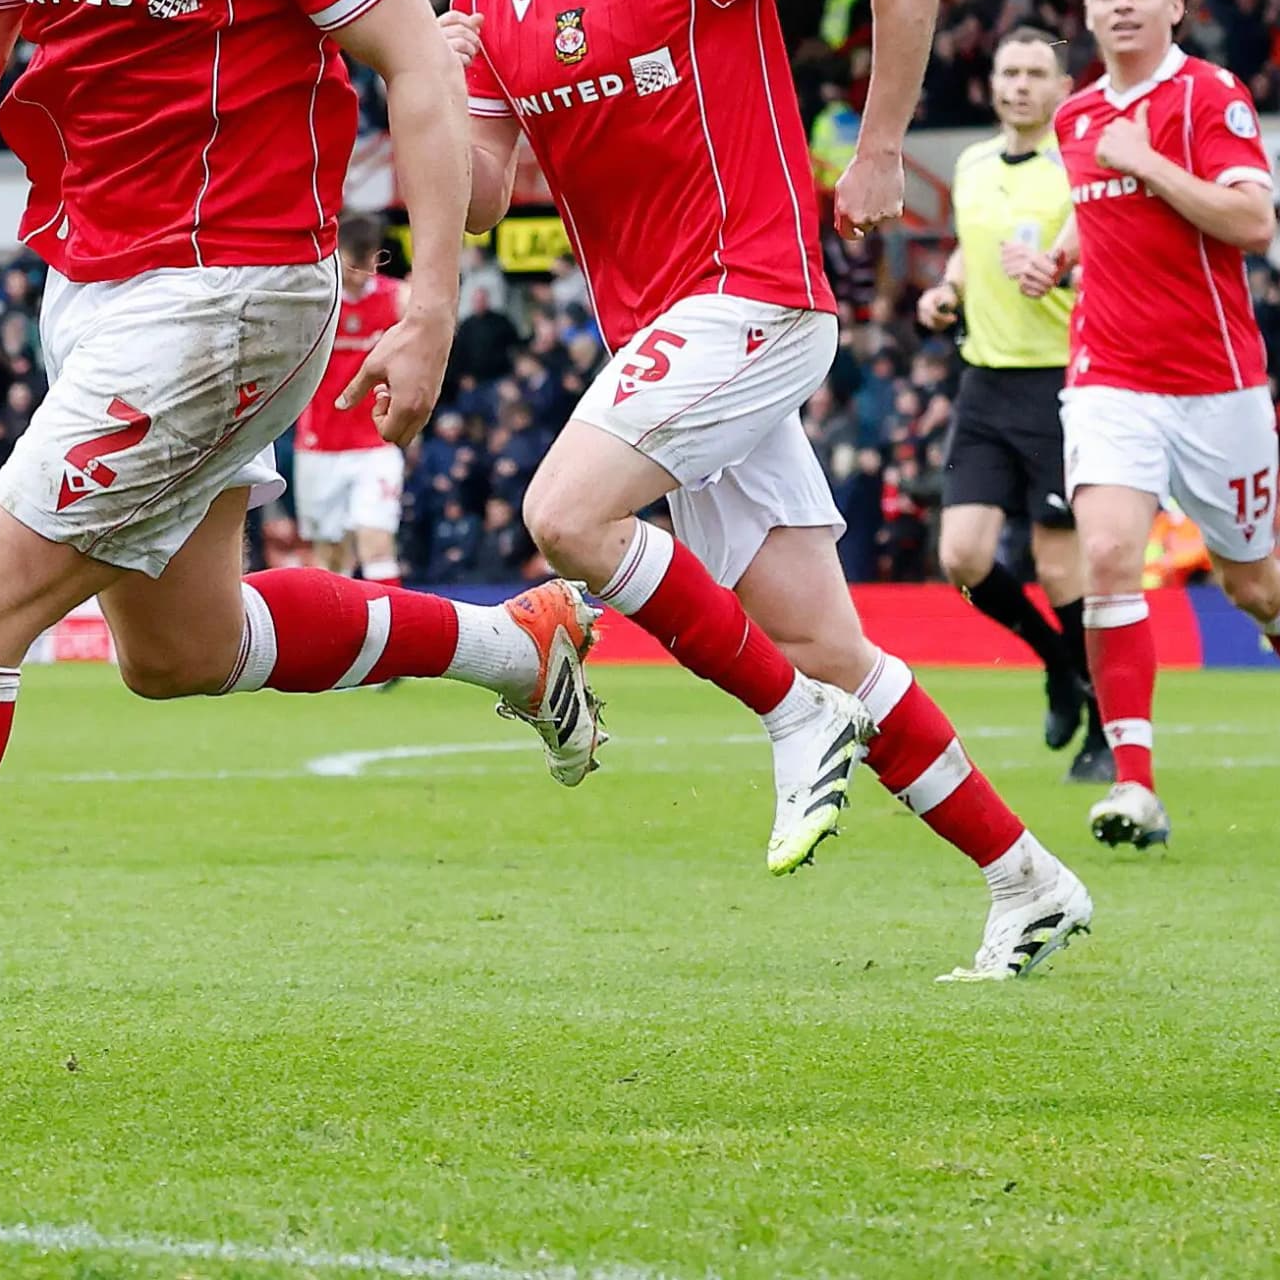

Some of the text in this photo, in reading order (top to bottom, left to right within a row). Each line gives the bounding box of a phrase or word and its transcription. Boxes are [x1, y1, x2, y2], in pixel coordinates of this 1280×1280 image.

[621, 329, 688, 382] 5
[64, 394, 152, 489] 2
[1228, 467, 1271, 524] 15
